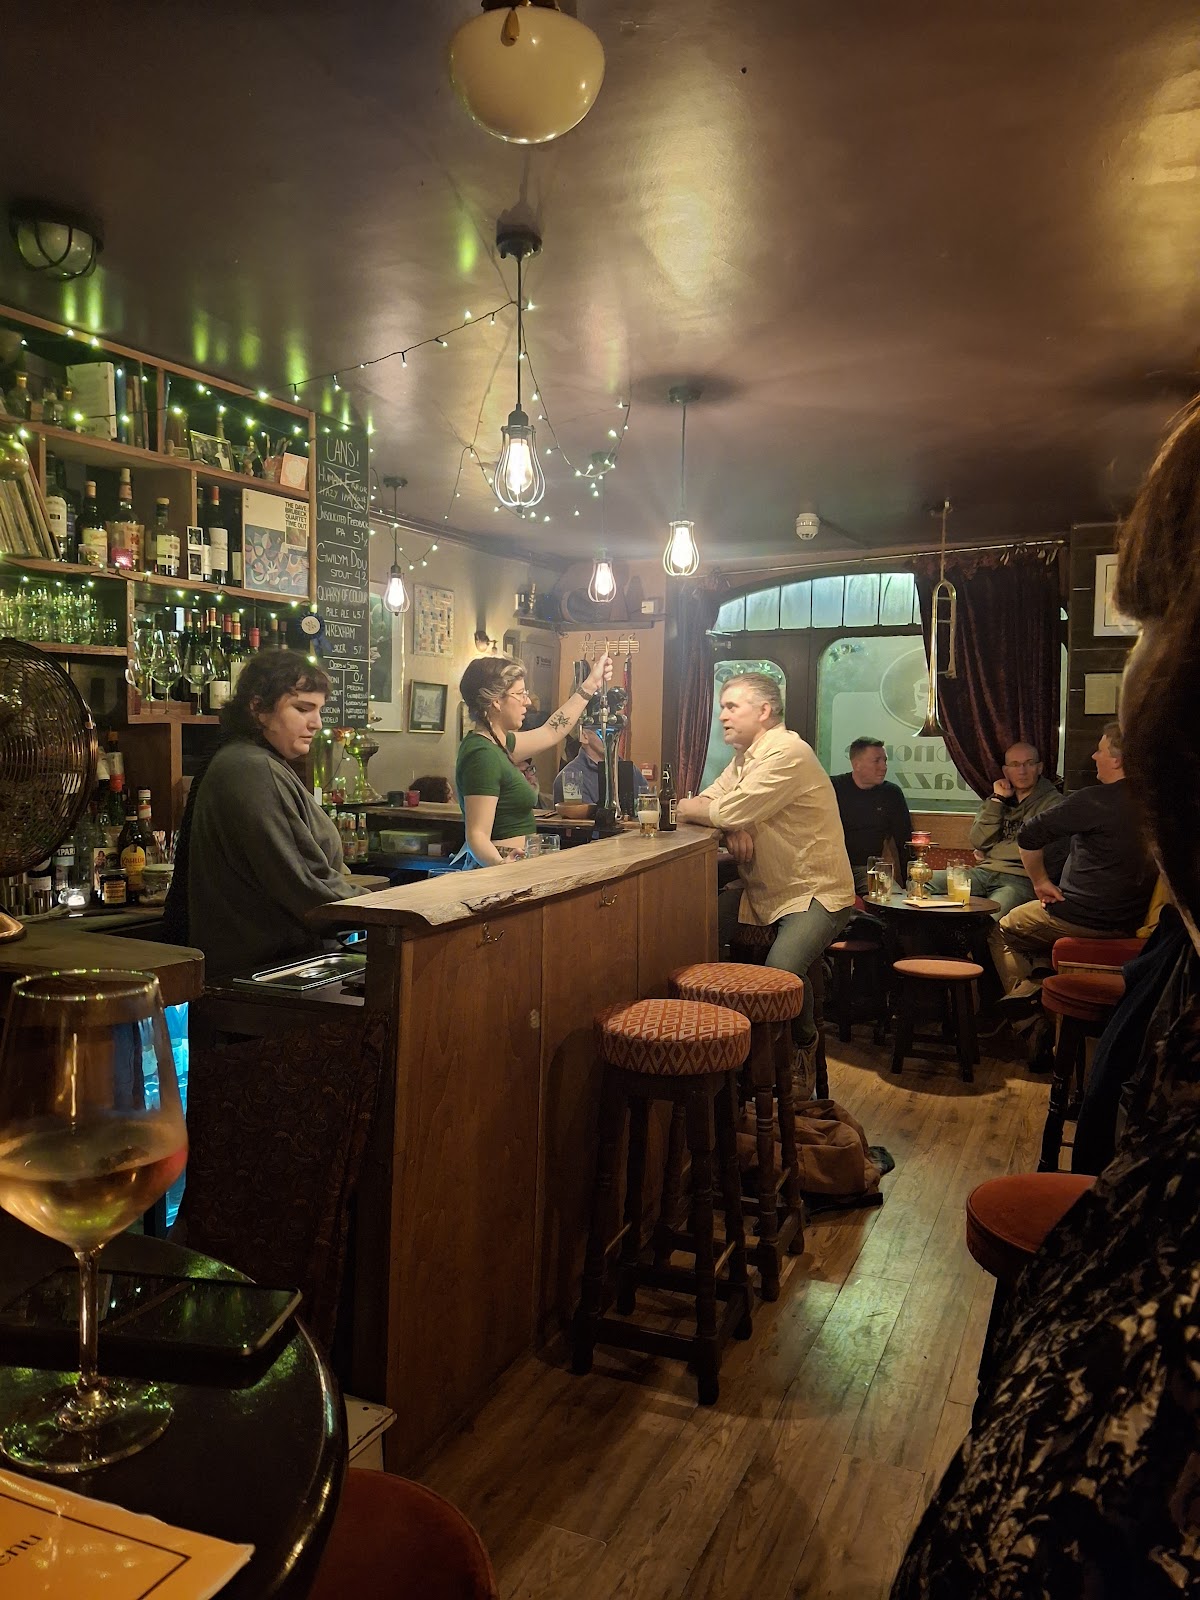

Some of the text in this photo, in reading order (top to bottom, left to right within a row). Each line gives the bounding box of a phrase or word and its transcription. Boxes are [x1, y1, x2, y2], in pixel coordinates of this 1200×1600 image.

[285, 501, 307, 512] THE DAVE
[284, 507, 307, 518] BRUBECK
[285, 513, 307, 524] QUARTET
[285, 519, 307, 530] TIME OUT
[331, 568, 353, 579] STOUT
[326, 606, 339, 618] PALE
[340, 609, 350, 619] ALE
[325, 624, 356, 640] WREXHAM
[57, 847, 75, 856] PARI
[0, 1533, 43, 1567] enu
